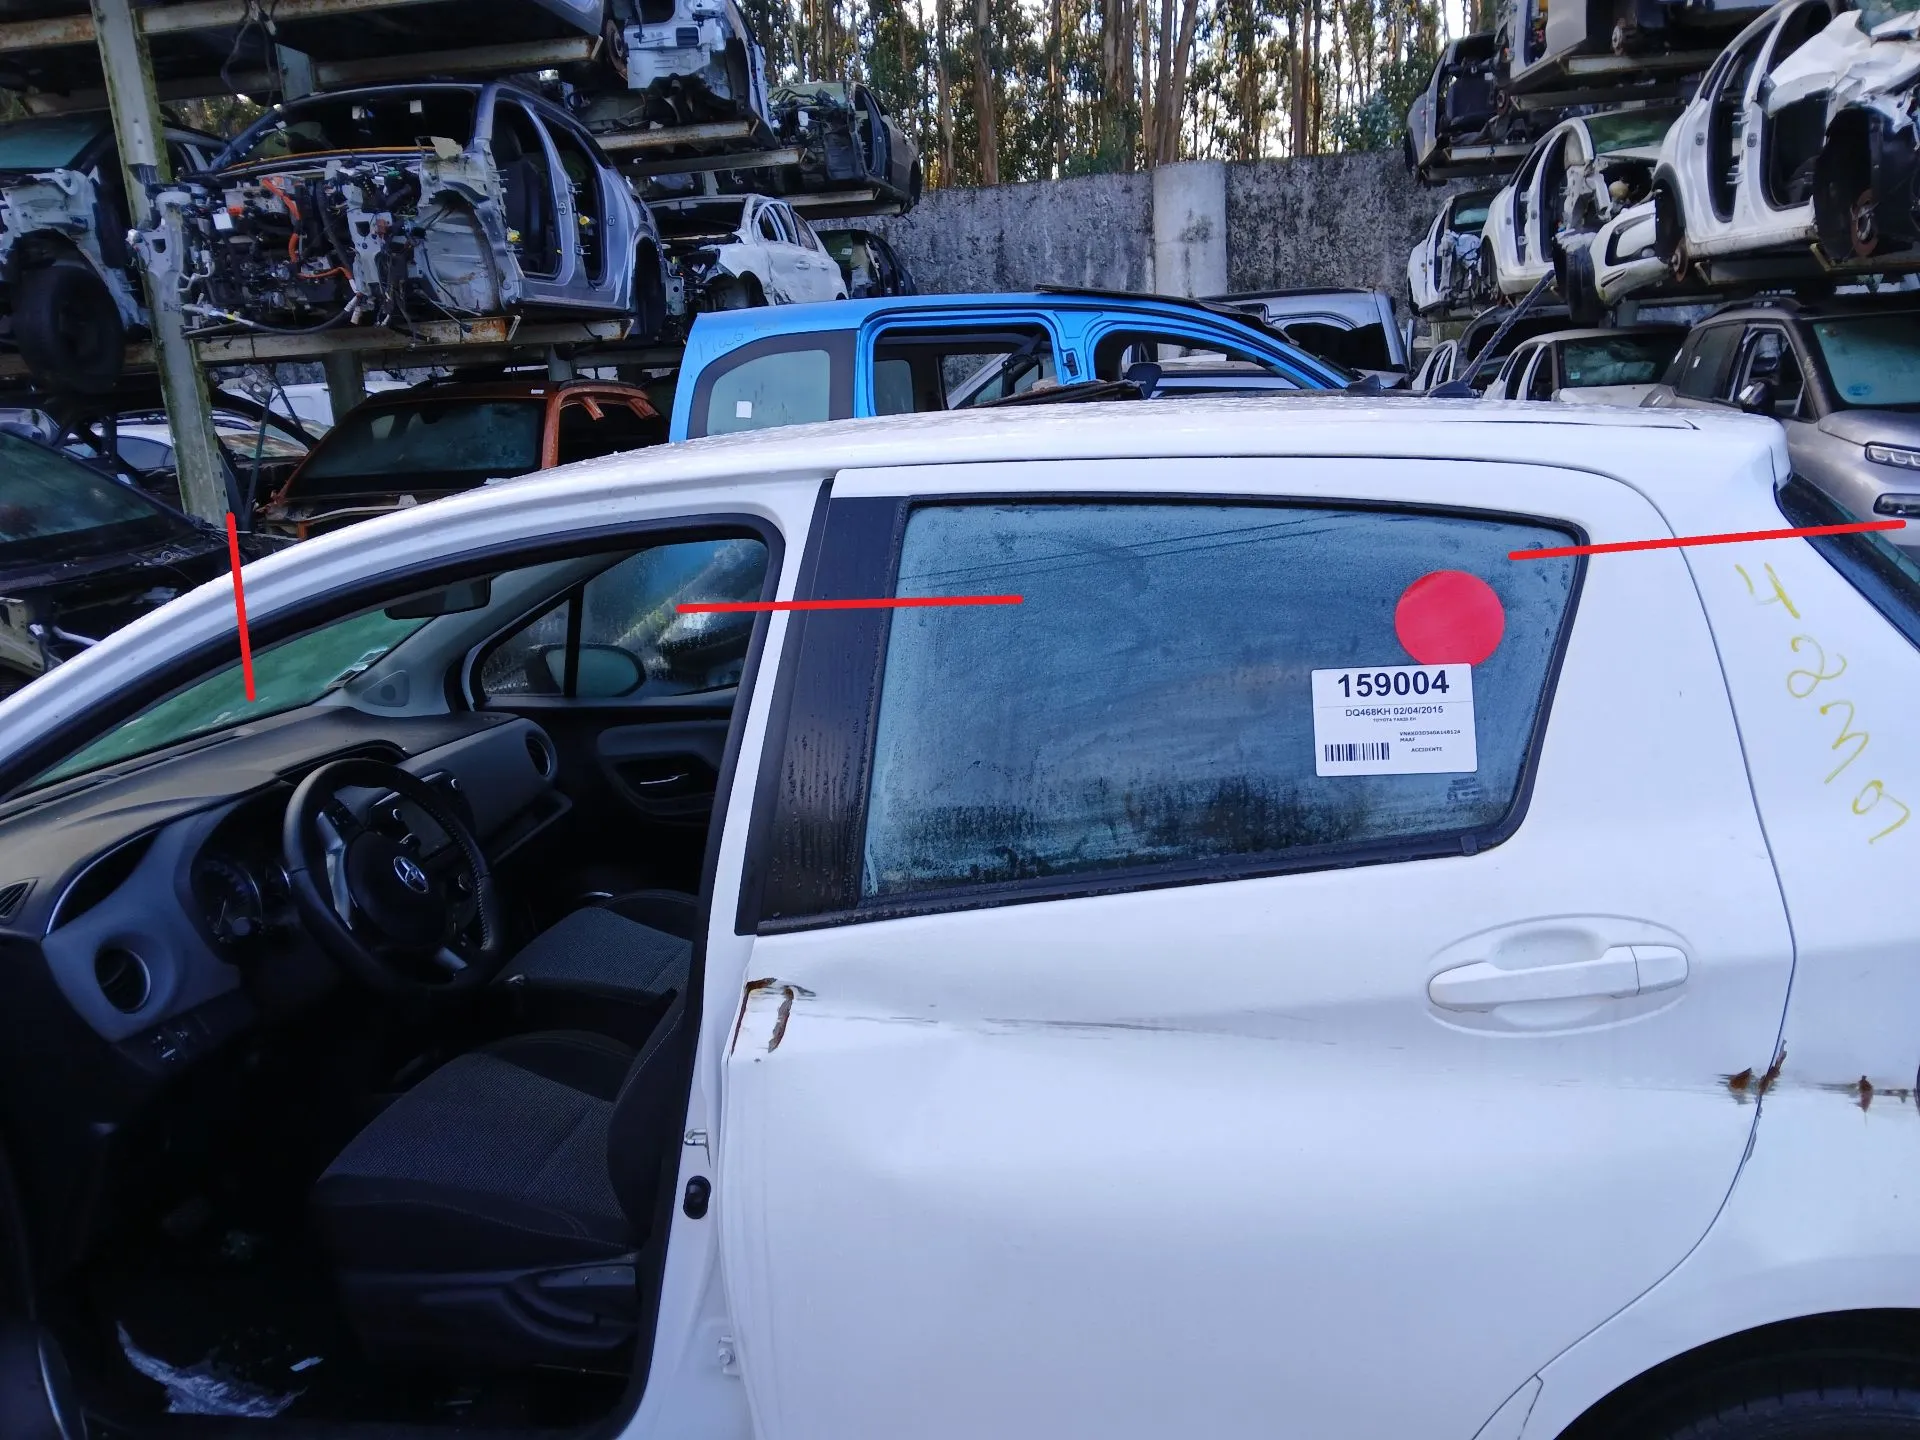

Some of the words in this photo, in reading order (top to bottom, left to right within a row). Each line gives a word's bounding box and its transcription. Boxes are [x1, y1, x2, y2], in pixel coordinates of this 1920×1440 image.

[1337, 670, 1450, 698] 159004
[1345, 708, 1391, 717] DQ468KH
[1393, 705, 1444, 716] 02/04/2015
